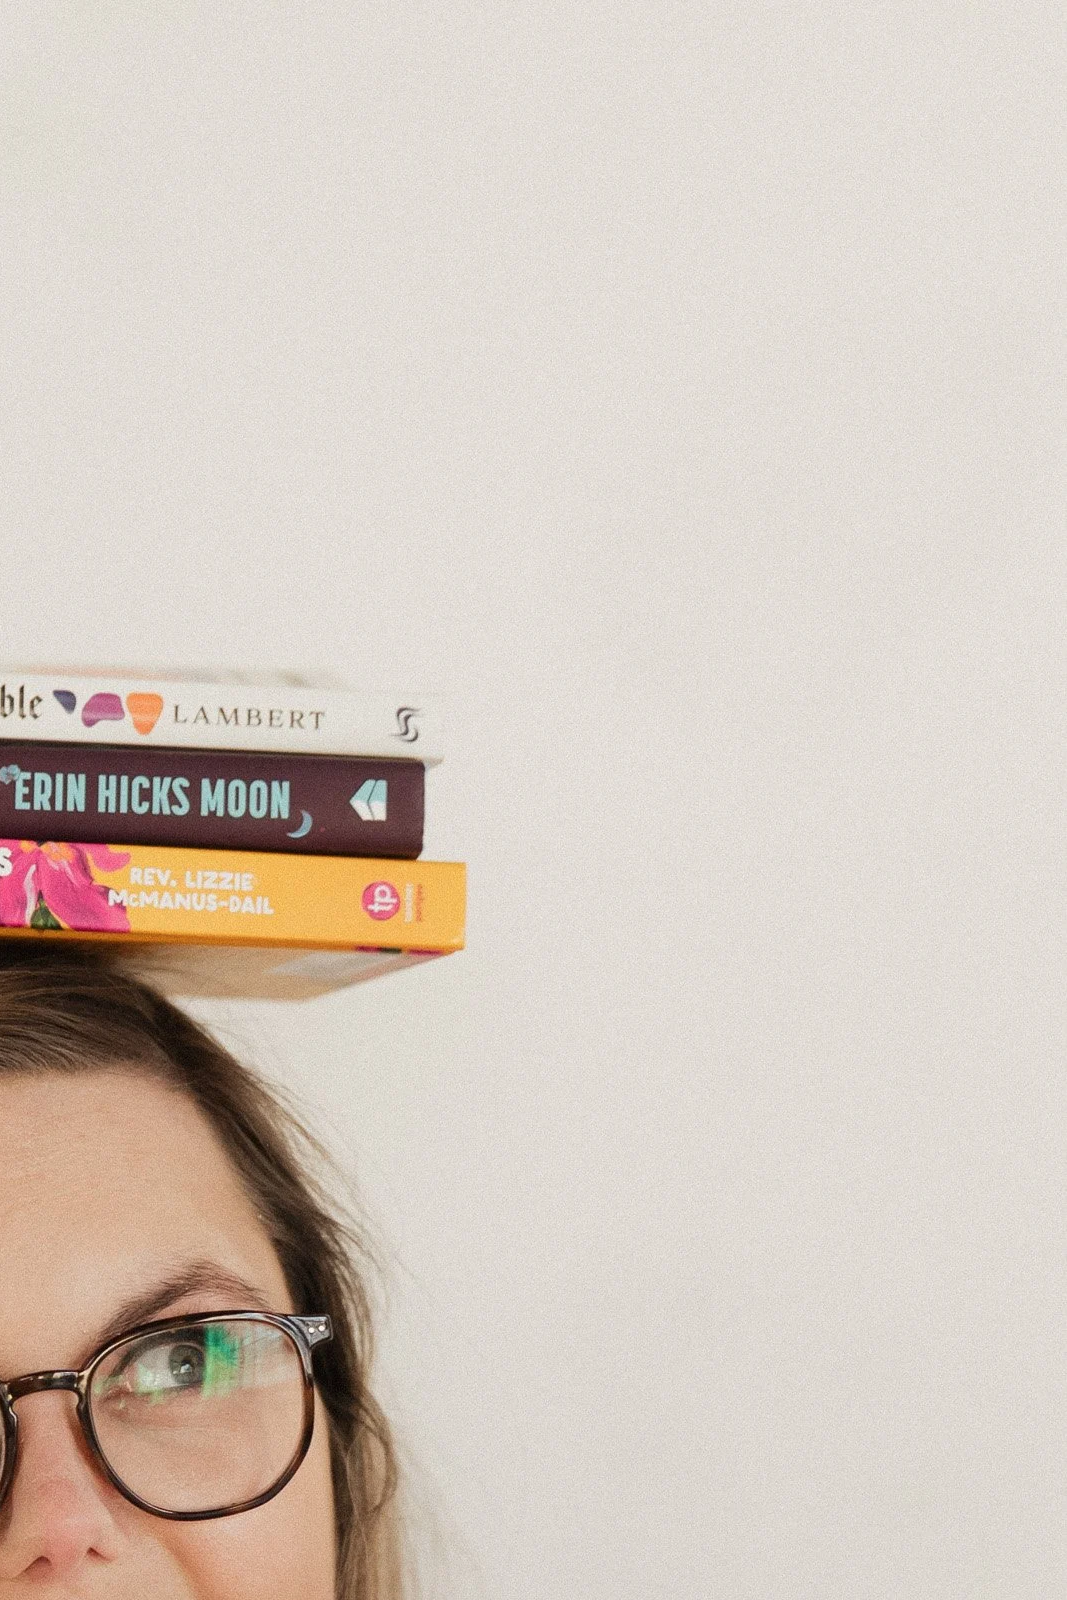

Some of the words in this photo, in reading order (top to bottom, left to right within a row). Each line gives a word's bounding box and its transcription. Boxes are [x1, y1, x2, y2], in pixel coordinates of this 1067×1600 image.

[173, 704, 325, 731] LAMBERT
[14, 771, 86, 812] ERIN
[97, 774, 191, 817] HICKS
[200, 778, 291, 819] MOON
[129, 867, 177, 888] REV.
[185, 870, 255, 891] LIZZIE
